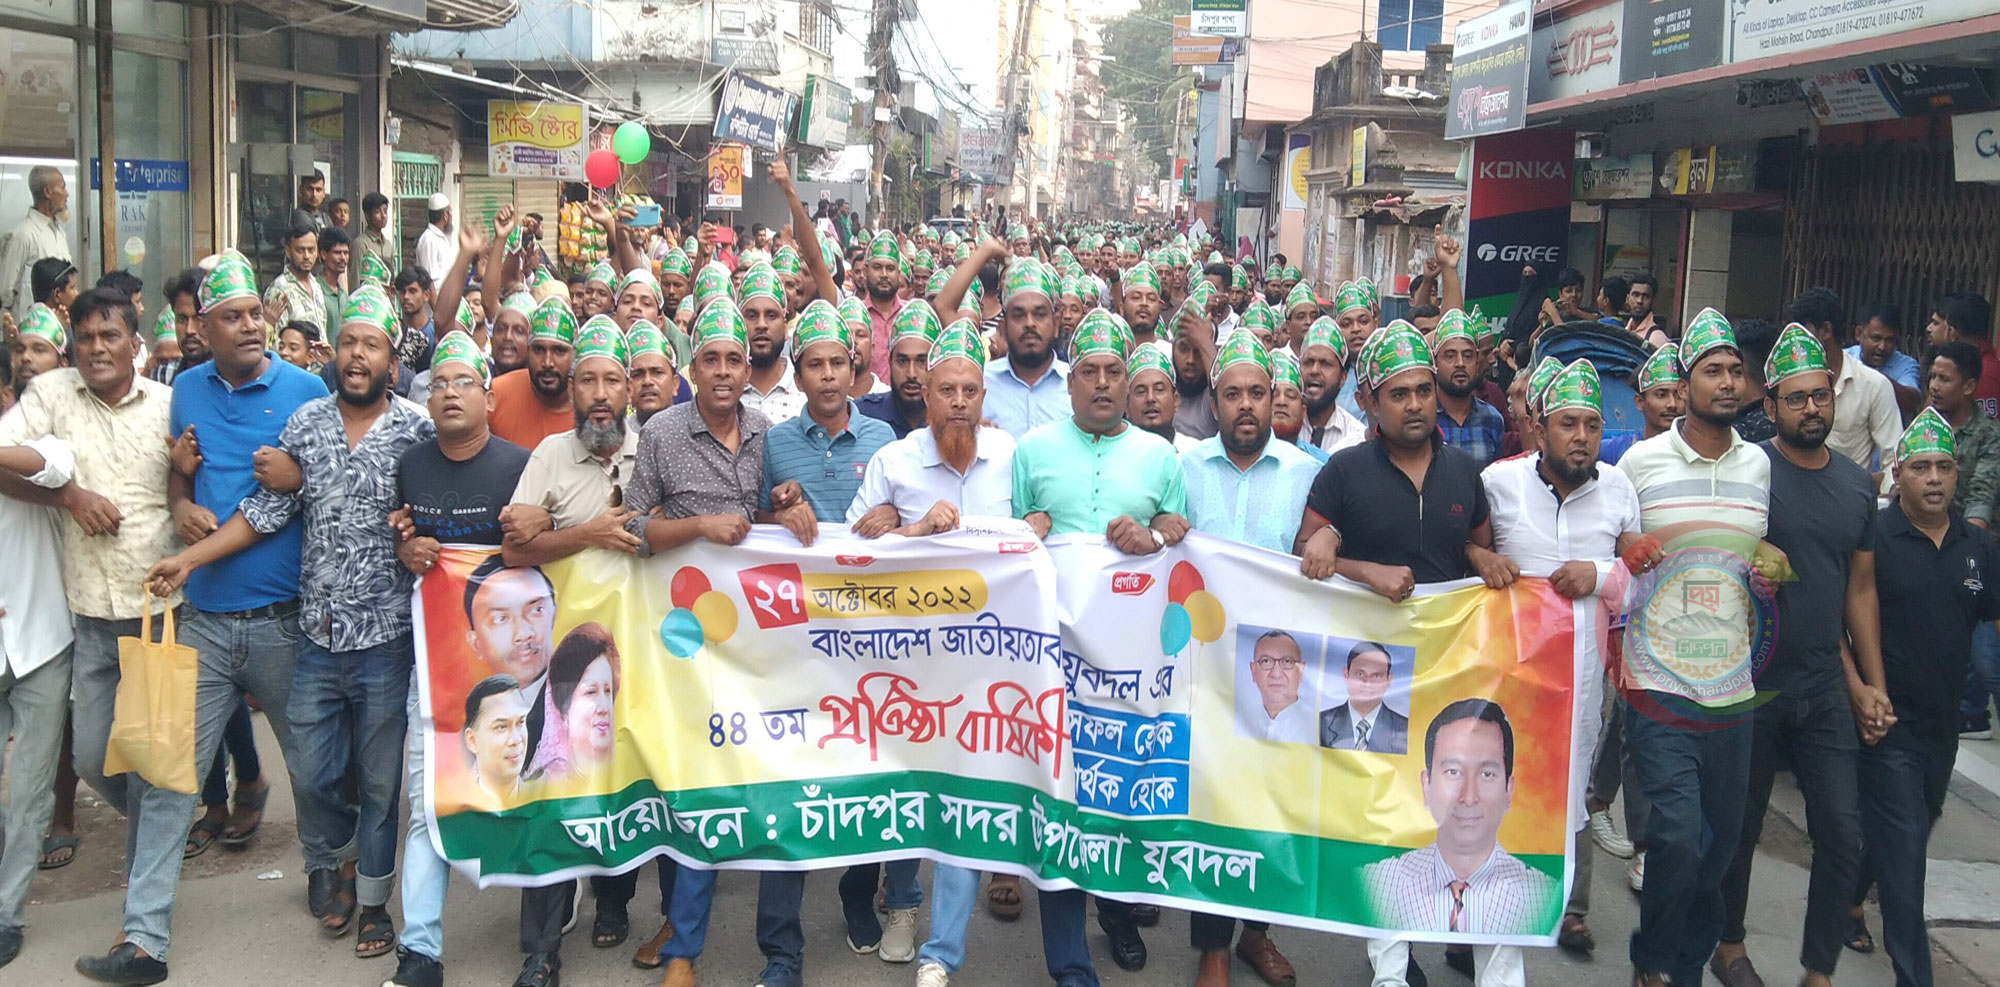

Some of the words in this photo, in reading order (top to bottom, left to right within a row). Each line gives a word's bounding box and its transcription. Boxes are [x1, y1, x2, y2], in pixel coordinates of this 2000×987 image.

[1201, 13, 1220, 24] চাঁদপুর
[1222, 15, 1236, 24] শাখা
[1808, 6, 1818, 20] CC
[1818, 3, 1841, 18] Camera
[1461, 31, 1475, 46] GREE
[1481, 23, 1499, 41] KONKA
[1771, 35, 1788, 47] Mohsin
[1879, 6, 1924, 26] 01819-477672
[717, 40, 737, 48] Phone
[124, 164, 184, 188] terprise
[1480, 161, 1566, 179] KONKA
[121, 204, 146, 221] RAK
[1500, 245, 1560, 262] GREE
[413, 504, 442, 515] DOLCE
[1114, 572, 1140, 590] প্রগতি
[754, 579, 800, 621] ২৭
[812, 579, 898, 613] অক্টোবর
[907, 585, 976, 613] ২০২২
[809, 627, 931, 662] বাংলাদেশ
[939, 612, 1063, 669] জাতীয়তাব
[1062, 649, 1142, 702] যুবদল
[1150, 665, 1175, 700] এর
[709, 711, 747, 748] ৪৪
[758, 707, 809, 743] তম
[817, 671, 964, 761] প্রতিষ্ঠা
[956, 681, 1071, 781] বার্ষিকী
[1068, 708, 1128, 753] সফল
[1074, 759, 1124, 806] ার্থক
[1130, 773, 1178, 814] হোক
[792, 783, 931, 844] চাঁদপুর
[938, 793, 1024, 847] সদর
[1029, 794, 1132, 876] উপেলা
[1141, 840, 1265, 893] যুবদল
